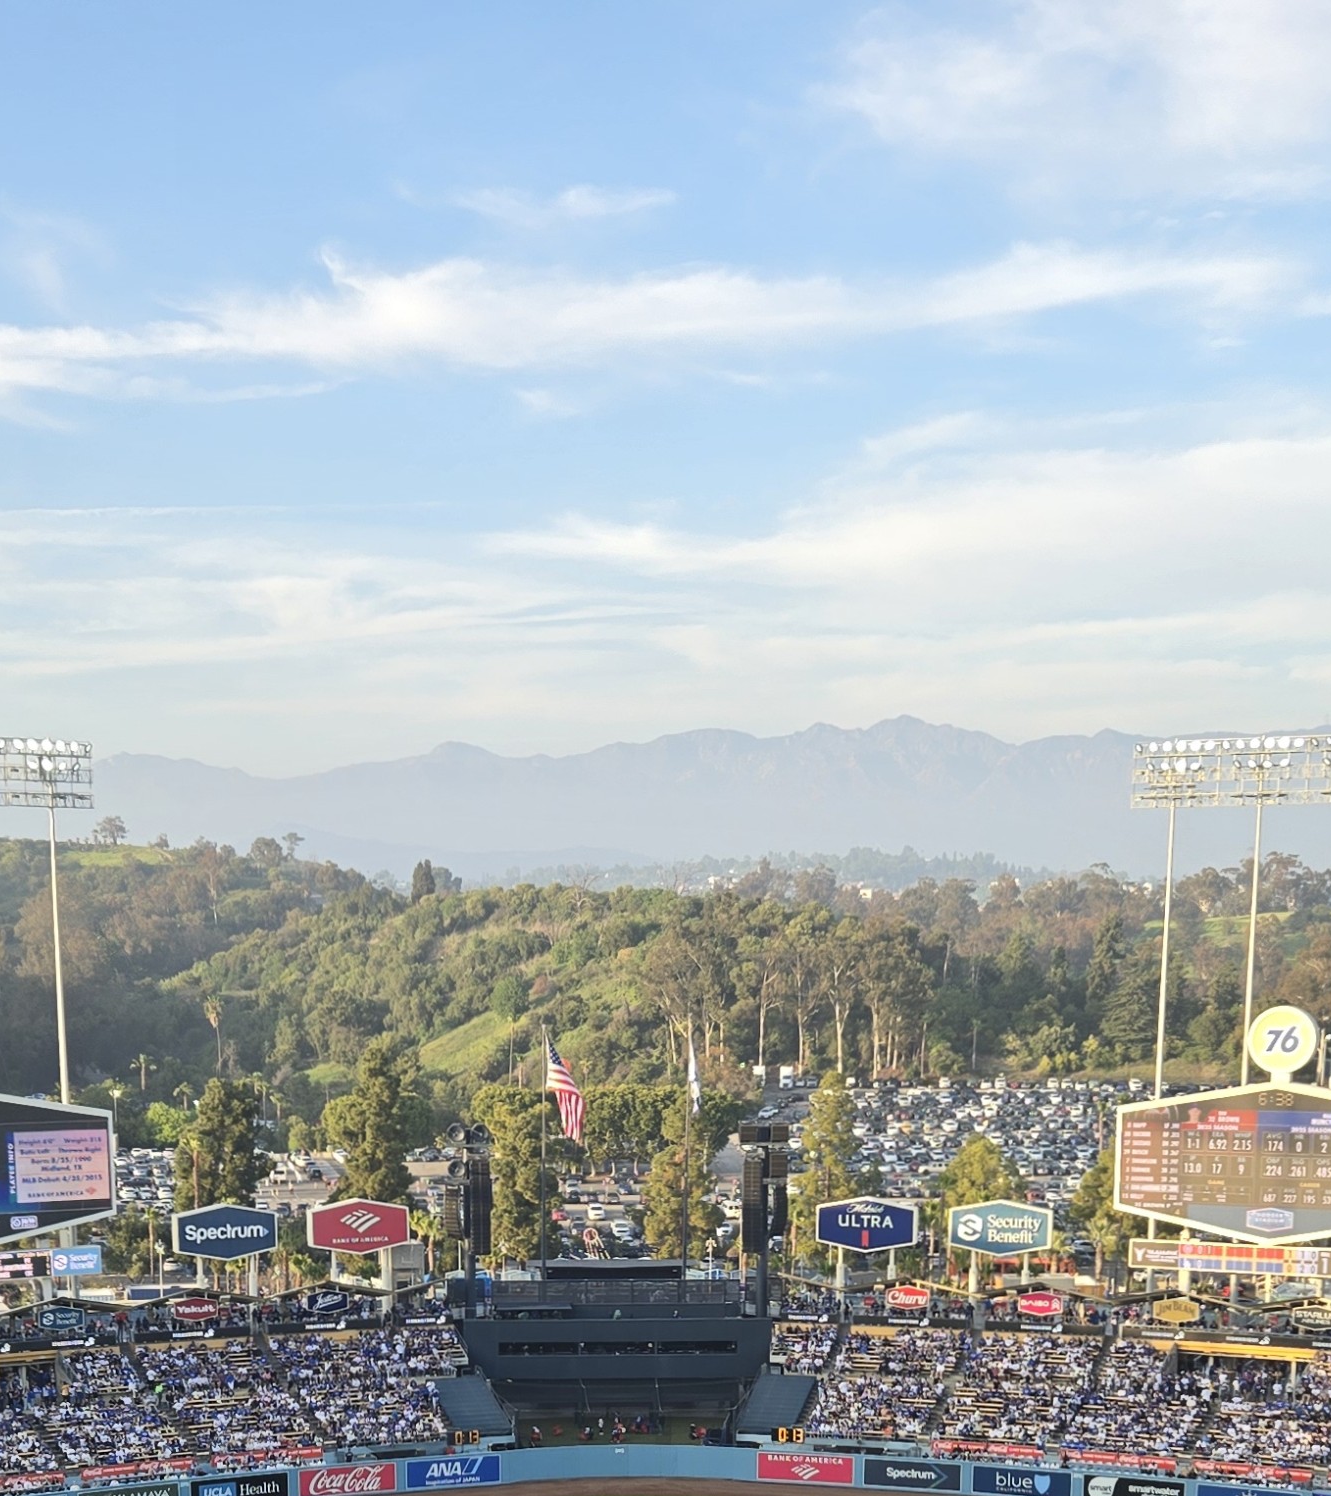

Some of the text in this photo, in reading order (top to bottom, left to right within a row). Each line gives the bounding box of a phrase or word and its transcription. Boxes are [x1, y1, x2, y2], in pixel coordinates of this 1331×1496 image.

[1265, 1026, 1299, 1053] 76
[1258, 1093, 1294, 1106] 6:38
[1208, 1139, 1227, 1150] 6.92
[1233, 1140, 1252, 1151] 2.15
[1264, 1141, 1284, 1152] .174
[1320, 1142, 1328, 1153] 2
[7, 1143, 15, 1168] INFO
[1184, 1163, 1202, 1173] 13.0
[1211, 1163, 1222, 1174] 17
[1238, 1164, 1244, 1175] 9
[1263, 1166, 1282, 1176] .224
[1288, 1166, 1307, 1177] .261
[8, 1169, 17, 1194] PLAYER
[838, 1214, 894, 1230] ULTRA
[986, 1214, 1042, 1233] Security
[184, 1223, 264, 1244] Spectrum
[987, 1229, 1035, 1245] Benefit
[888, 1289, 928, 1307] Churu
[1021, 1299, 1049, 1307] DAISO
[177, 1303, 216, 1314] Yakult
[1301, 1318, 1331, 1326] AIRLINES
[454, 1431, 480, 1445] 0:13
[777, 1427, 804, 1443] 0:13
[767, 1454, 844, 1465] BANK OF AMERICA
[425, 1461, 462, 1478] ANA
[886, 1466, 935, 1481] Spectrum
[308, 1464, 385, 1496] Coca-Cola
[996, 1471, 1033, 1488] blue
[239, 1480, 281, 1496] Health
[1128, 1484, 1180, 1496] smartwater
